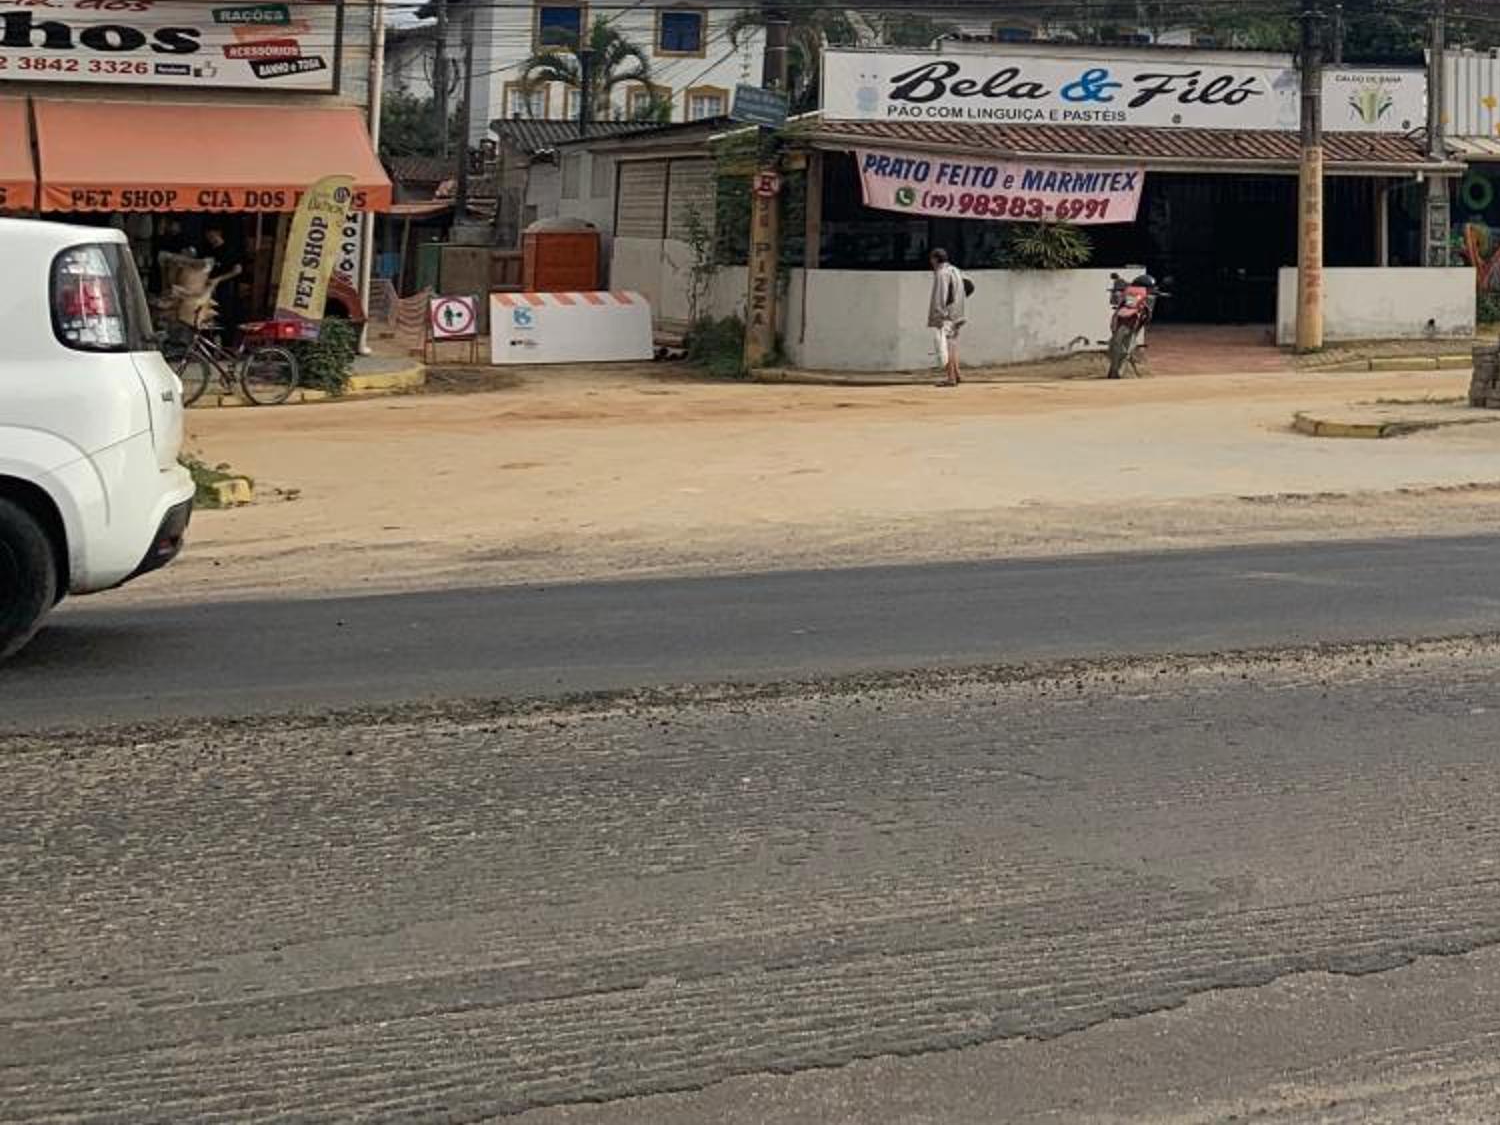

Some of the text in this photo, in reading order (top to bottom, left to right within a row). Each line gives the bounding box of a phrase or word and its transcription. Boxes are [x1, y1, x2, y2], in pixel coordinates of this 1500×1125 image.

[18, 57, 78, 72] 3842
[88, 59, 148, 74] 3326
[889, 60, 1051, 104] Bela
[1059, 68, 1122, 103] &
[887, 103, 1126, 122] PÃO COM LINGUIÇA E PASTÉIS
[862, 153, 1139, 192] PRATO FEITO e MARMITEX
[71, 189, 112, 207] PET
[121, 190, 177, 208] SHOP
[198, 190, 233, 208] CIA
[244, 190, 286, 208] DOS
[959, 193, 1111, 219] 98383-6991
[302, 216, 329, 269] SHOP
[294, 272, 317, 310] PET
